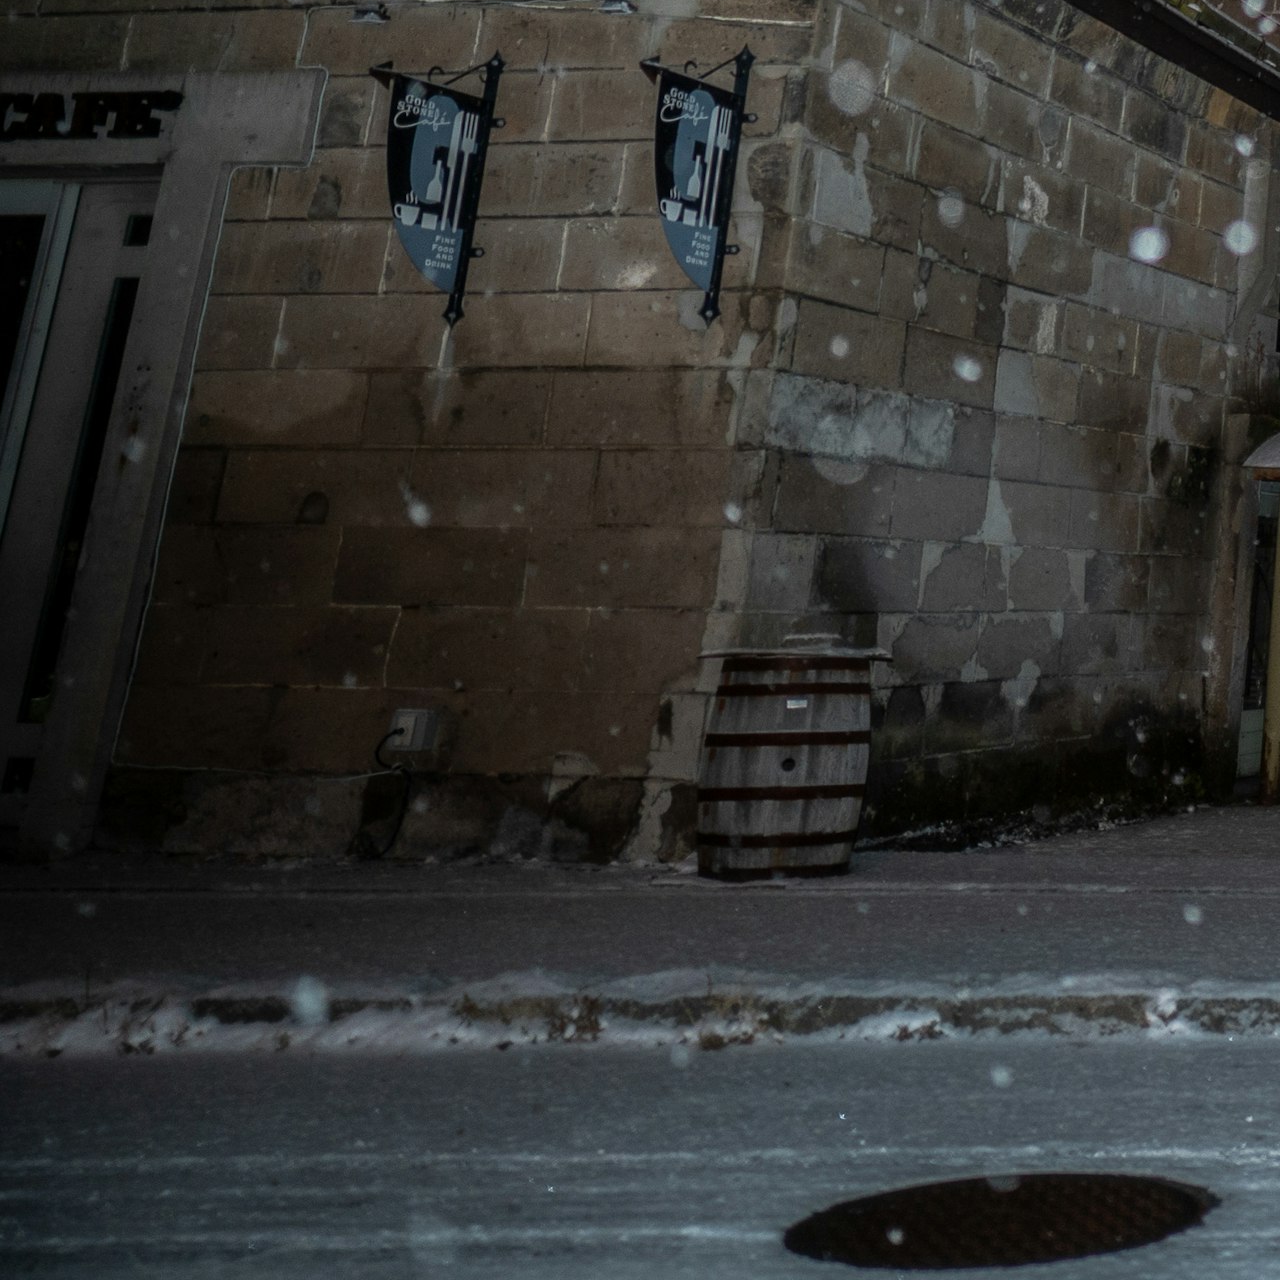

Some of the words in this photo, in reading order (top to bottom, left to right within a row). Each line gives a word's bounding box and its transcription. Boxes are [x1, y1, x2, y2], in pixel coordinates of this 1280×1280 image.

[405, 94, 436, 110] GOLD
[663, 94, 695, 113] STONE
[670, 86, 696, 104] GOLD
[397, 101, 434, 118] STONE
